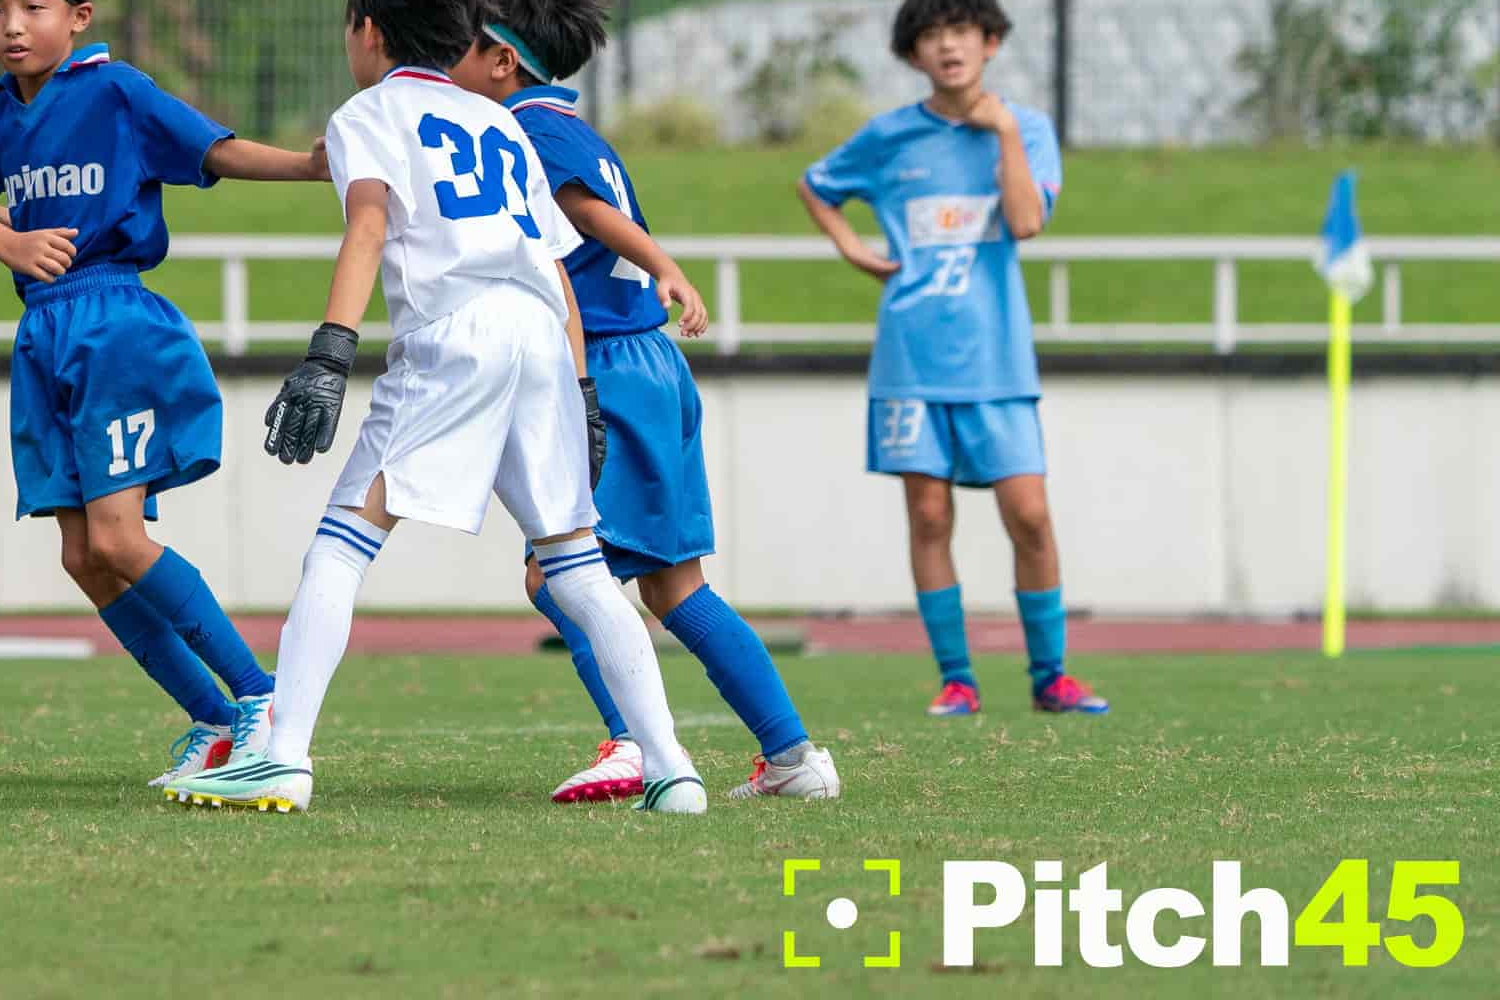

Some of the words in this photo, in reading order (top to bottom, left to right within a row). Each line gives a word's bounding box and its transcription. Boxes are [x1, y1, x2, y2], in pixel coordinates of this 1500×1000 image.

[4, 162, 105, 208] rimao
[418, 113, 541, 239] 30
[106, 408, 155, 476] 17
